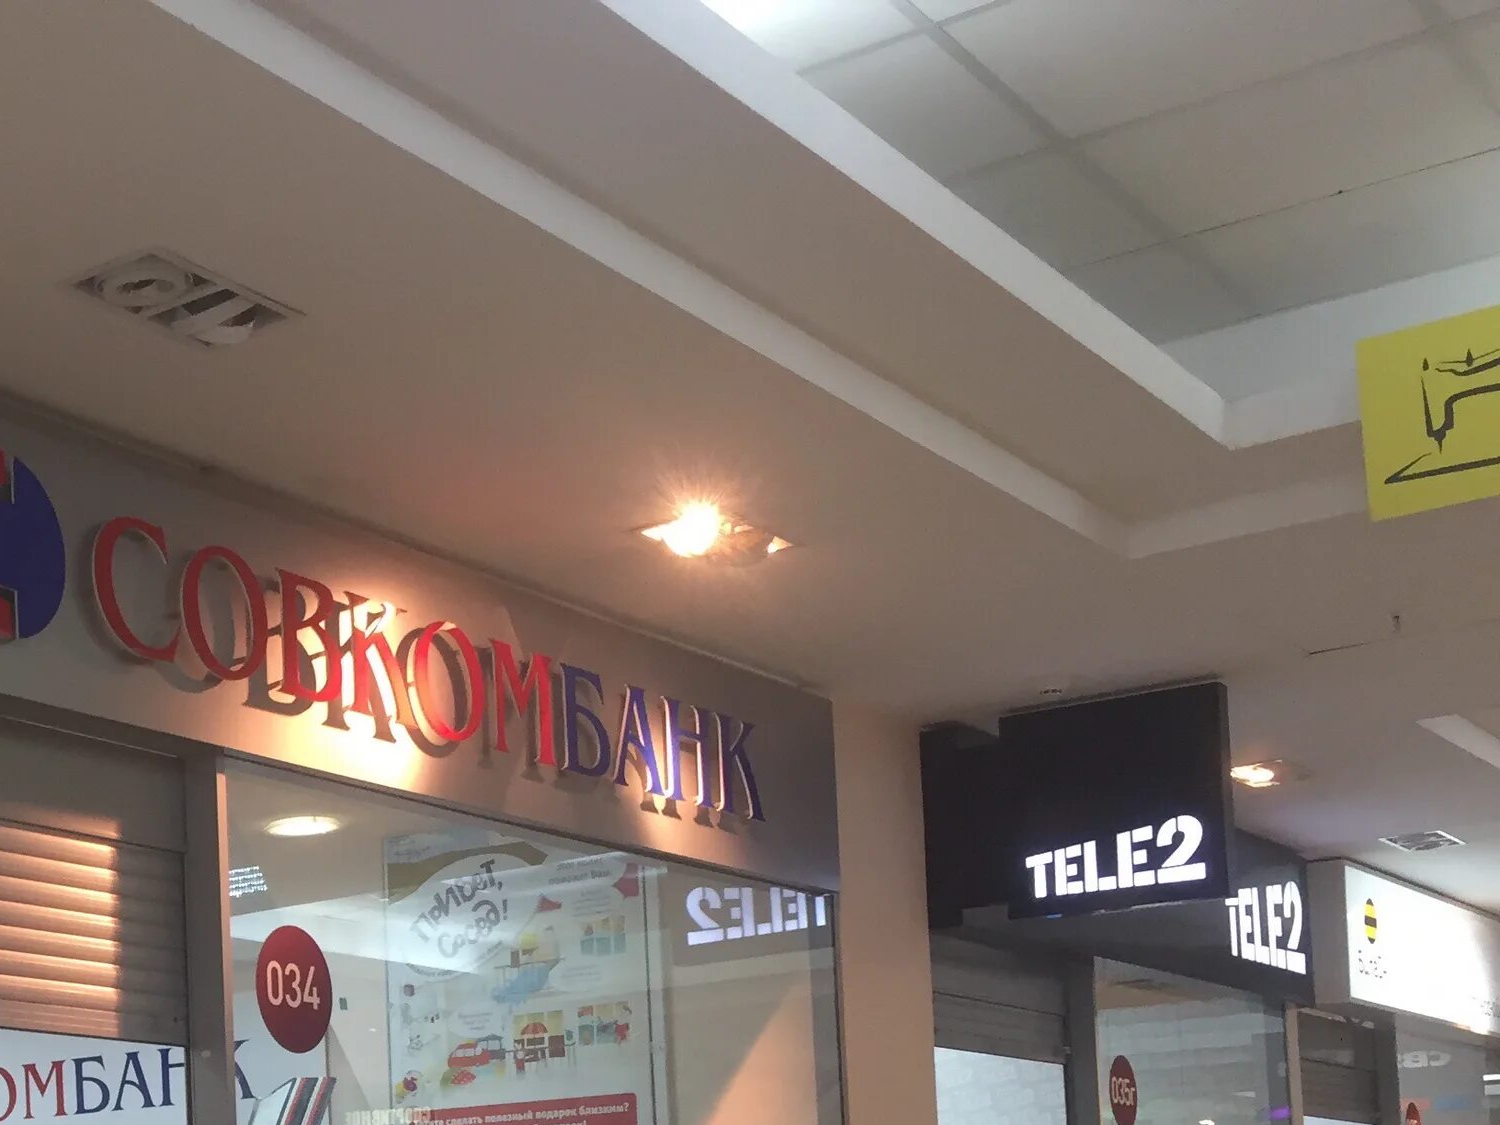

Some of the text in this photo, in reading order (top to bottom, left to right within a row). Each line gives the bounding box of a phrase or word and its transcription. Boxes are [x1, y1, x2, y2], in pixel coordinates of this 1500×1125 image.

[91, 515, 766, 822] СОВКОМБАНК
[1025, 815, 1207, 898] TELE2
[1225, 880, 1307, 975] TELE2
[266, 960, 320, 1010] 034
[485, 1110, 533, 1124] полезный
[535, 1109, 577, 1120] подарок
[579, 1102, 630, 1117] близким?
